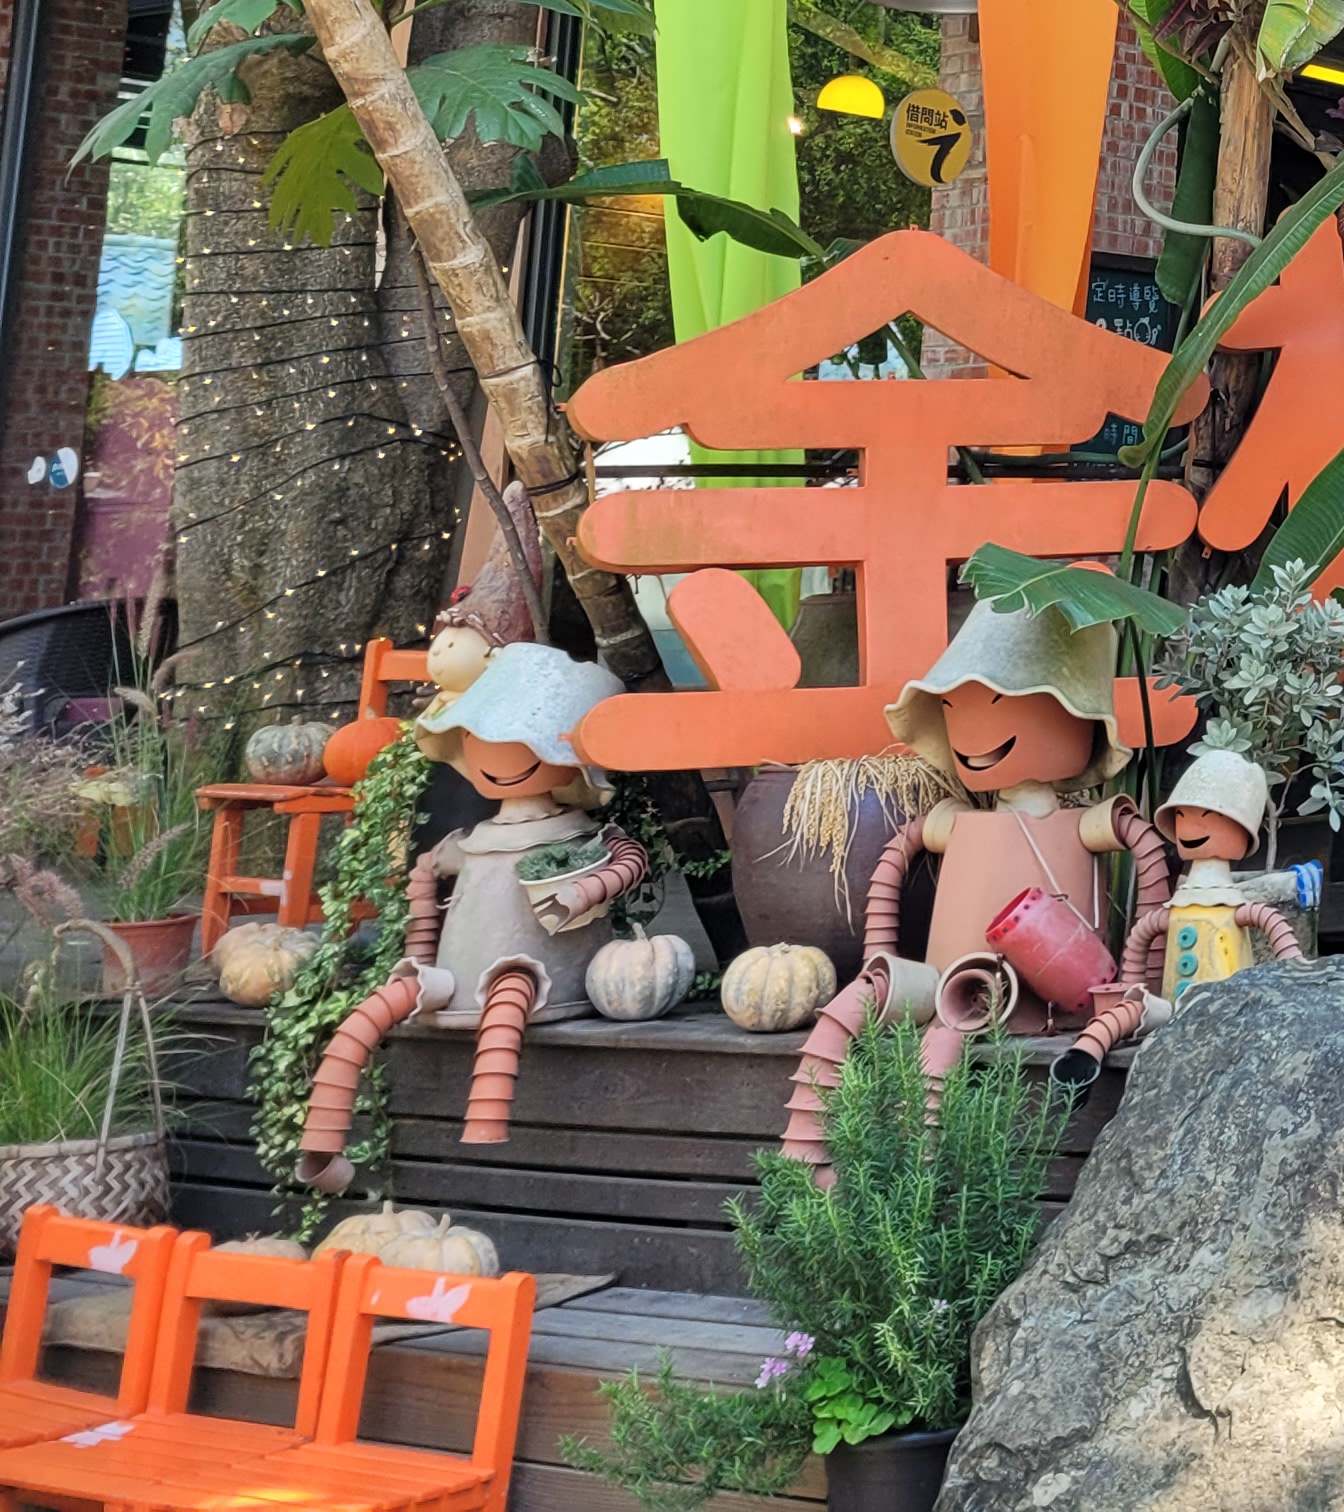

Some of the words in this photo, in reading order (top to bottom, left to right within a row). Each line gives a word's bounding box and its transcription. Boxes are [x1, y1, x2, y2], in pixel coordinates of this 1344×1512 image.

[906, 103, 949, 130] 借問站
[1091, 277, 1160, 313] 定時導覽
